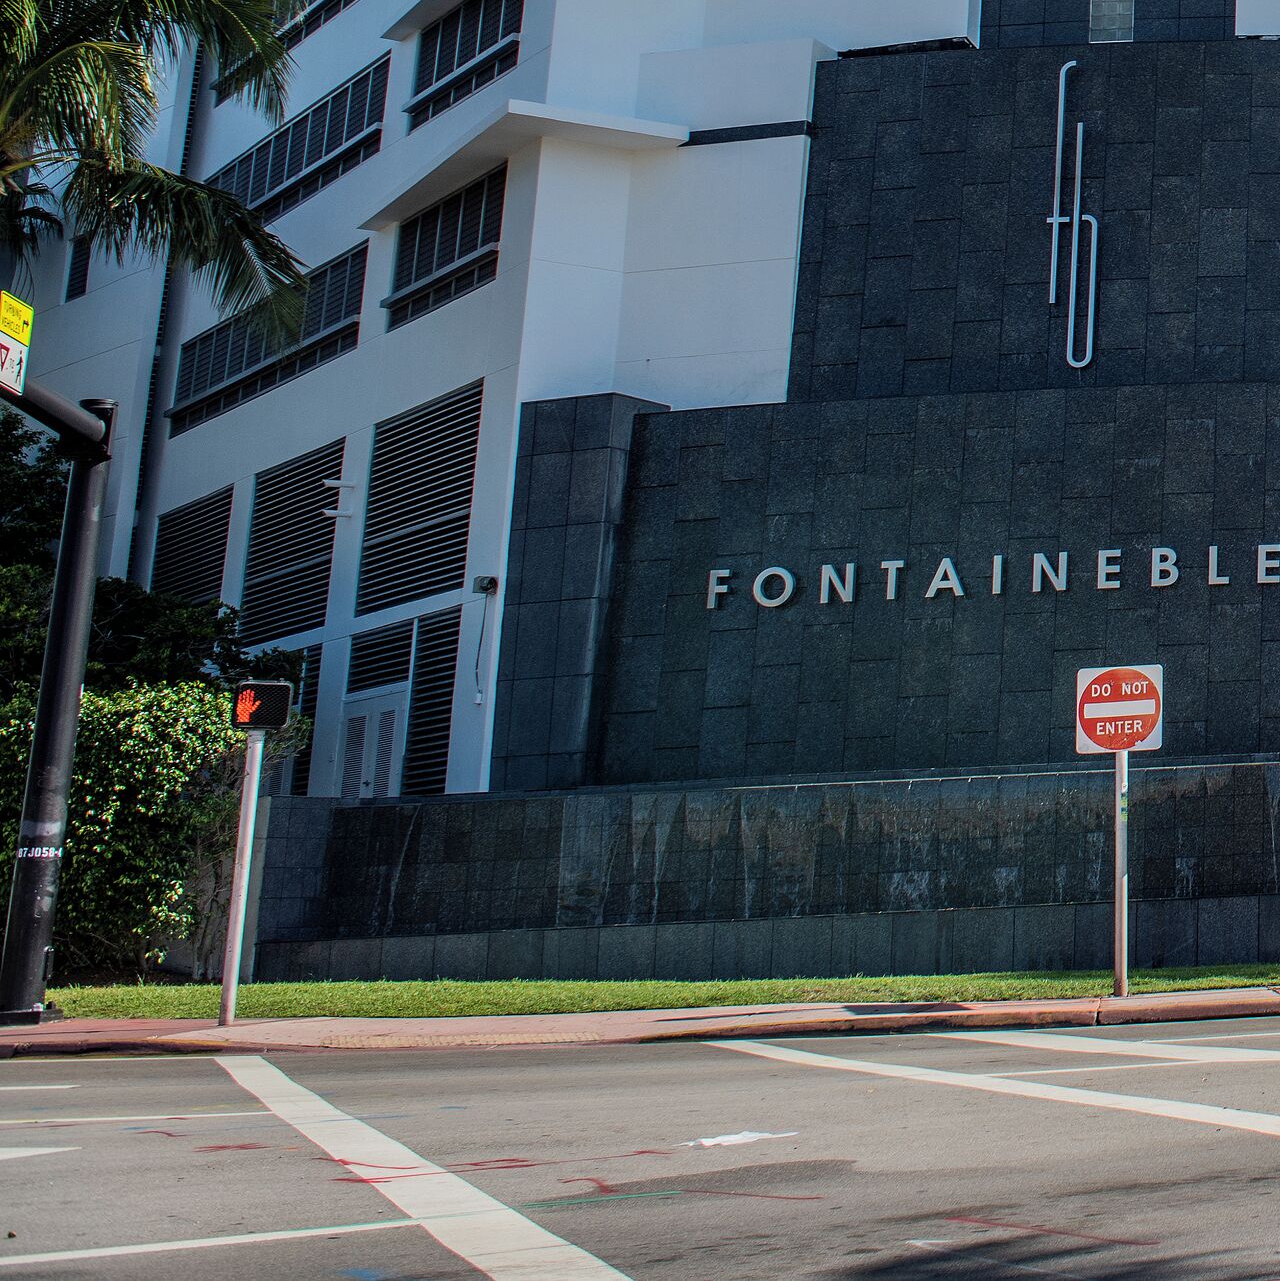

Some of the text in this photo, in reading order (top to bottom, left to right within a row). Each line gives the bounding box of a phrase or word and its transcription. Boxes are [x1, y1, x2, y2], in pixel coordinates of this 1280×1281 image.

[1091, 681, 1149, 697] DO NOT
[1096, 720, 1143, 735] ENTER
